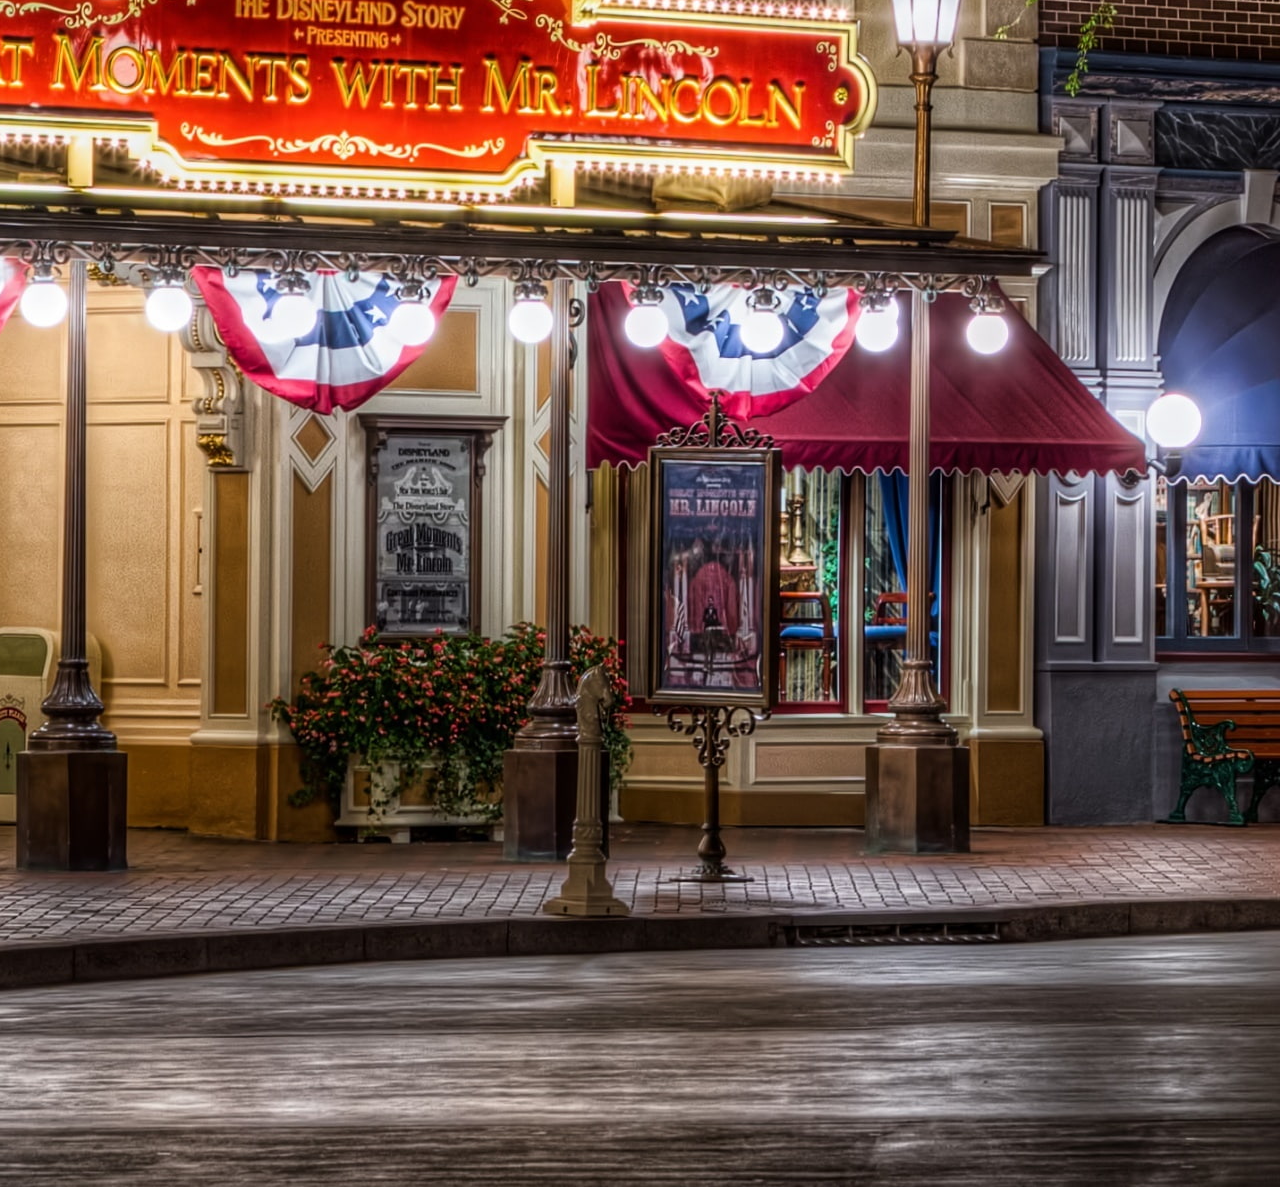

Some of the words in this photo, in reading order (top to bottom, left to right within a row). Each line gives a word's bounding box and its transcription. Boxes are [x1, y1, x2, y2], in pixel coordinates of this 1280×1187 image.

[401, 1, 466, 30] STORY
[306, 27, 389, 49] PRESENTING
[49, 31, 312, 105] MOMENTS
[330, 57, 464, 111] WITH
[481, 54, 574, 116] MR.
[584, 61, 807, 131] LINCOLN
[670, 499, 694, 516] MR.
[696, 499, 756, 517] LINCOLN
[386, 525, 413, 554] Great
[415, 523, 463, 555] Moments
[416, 553, 454, 574] Lincoln
